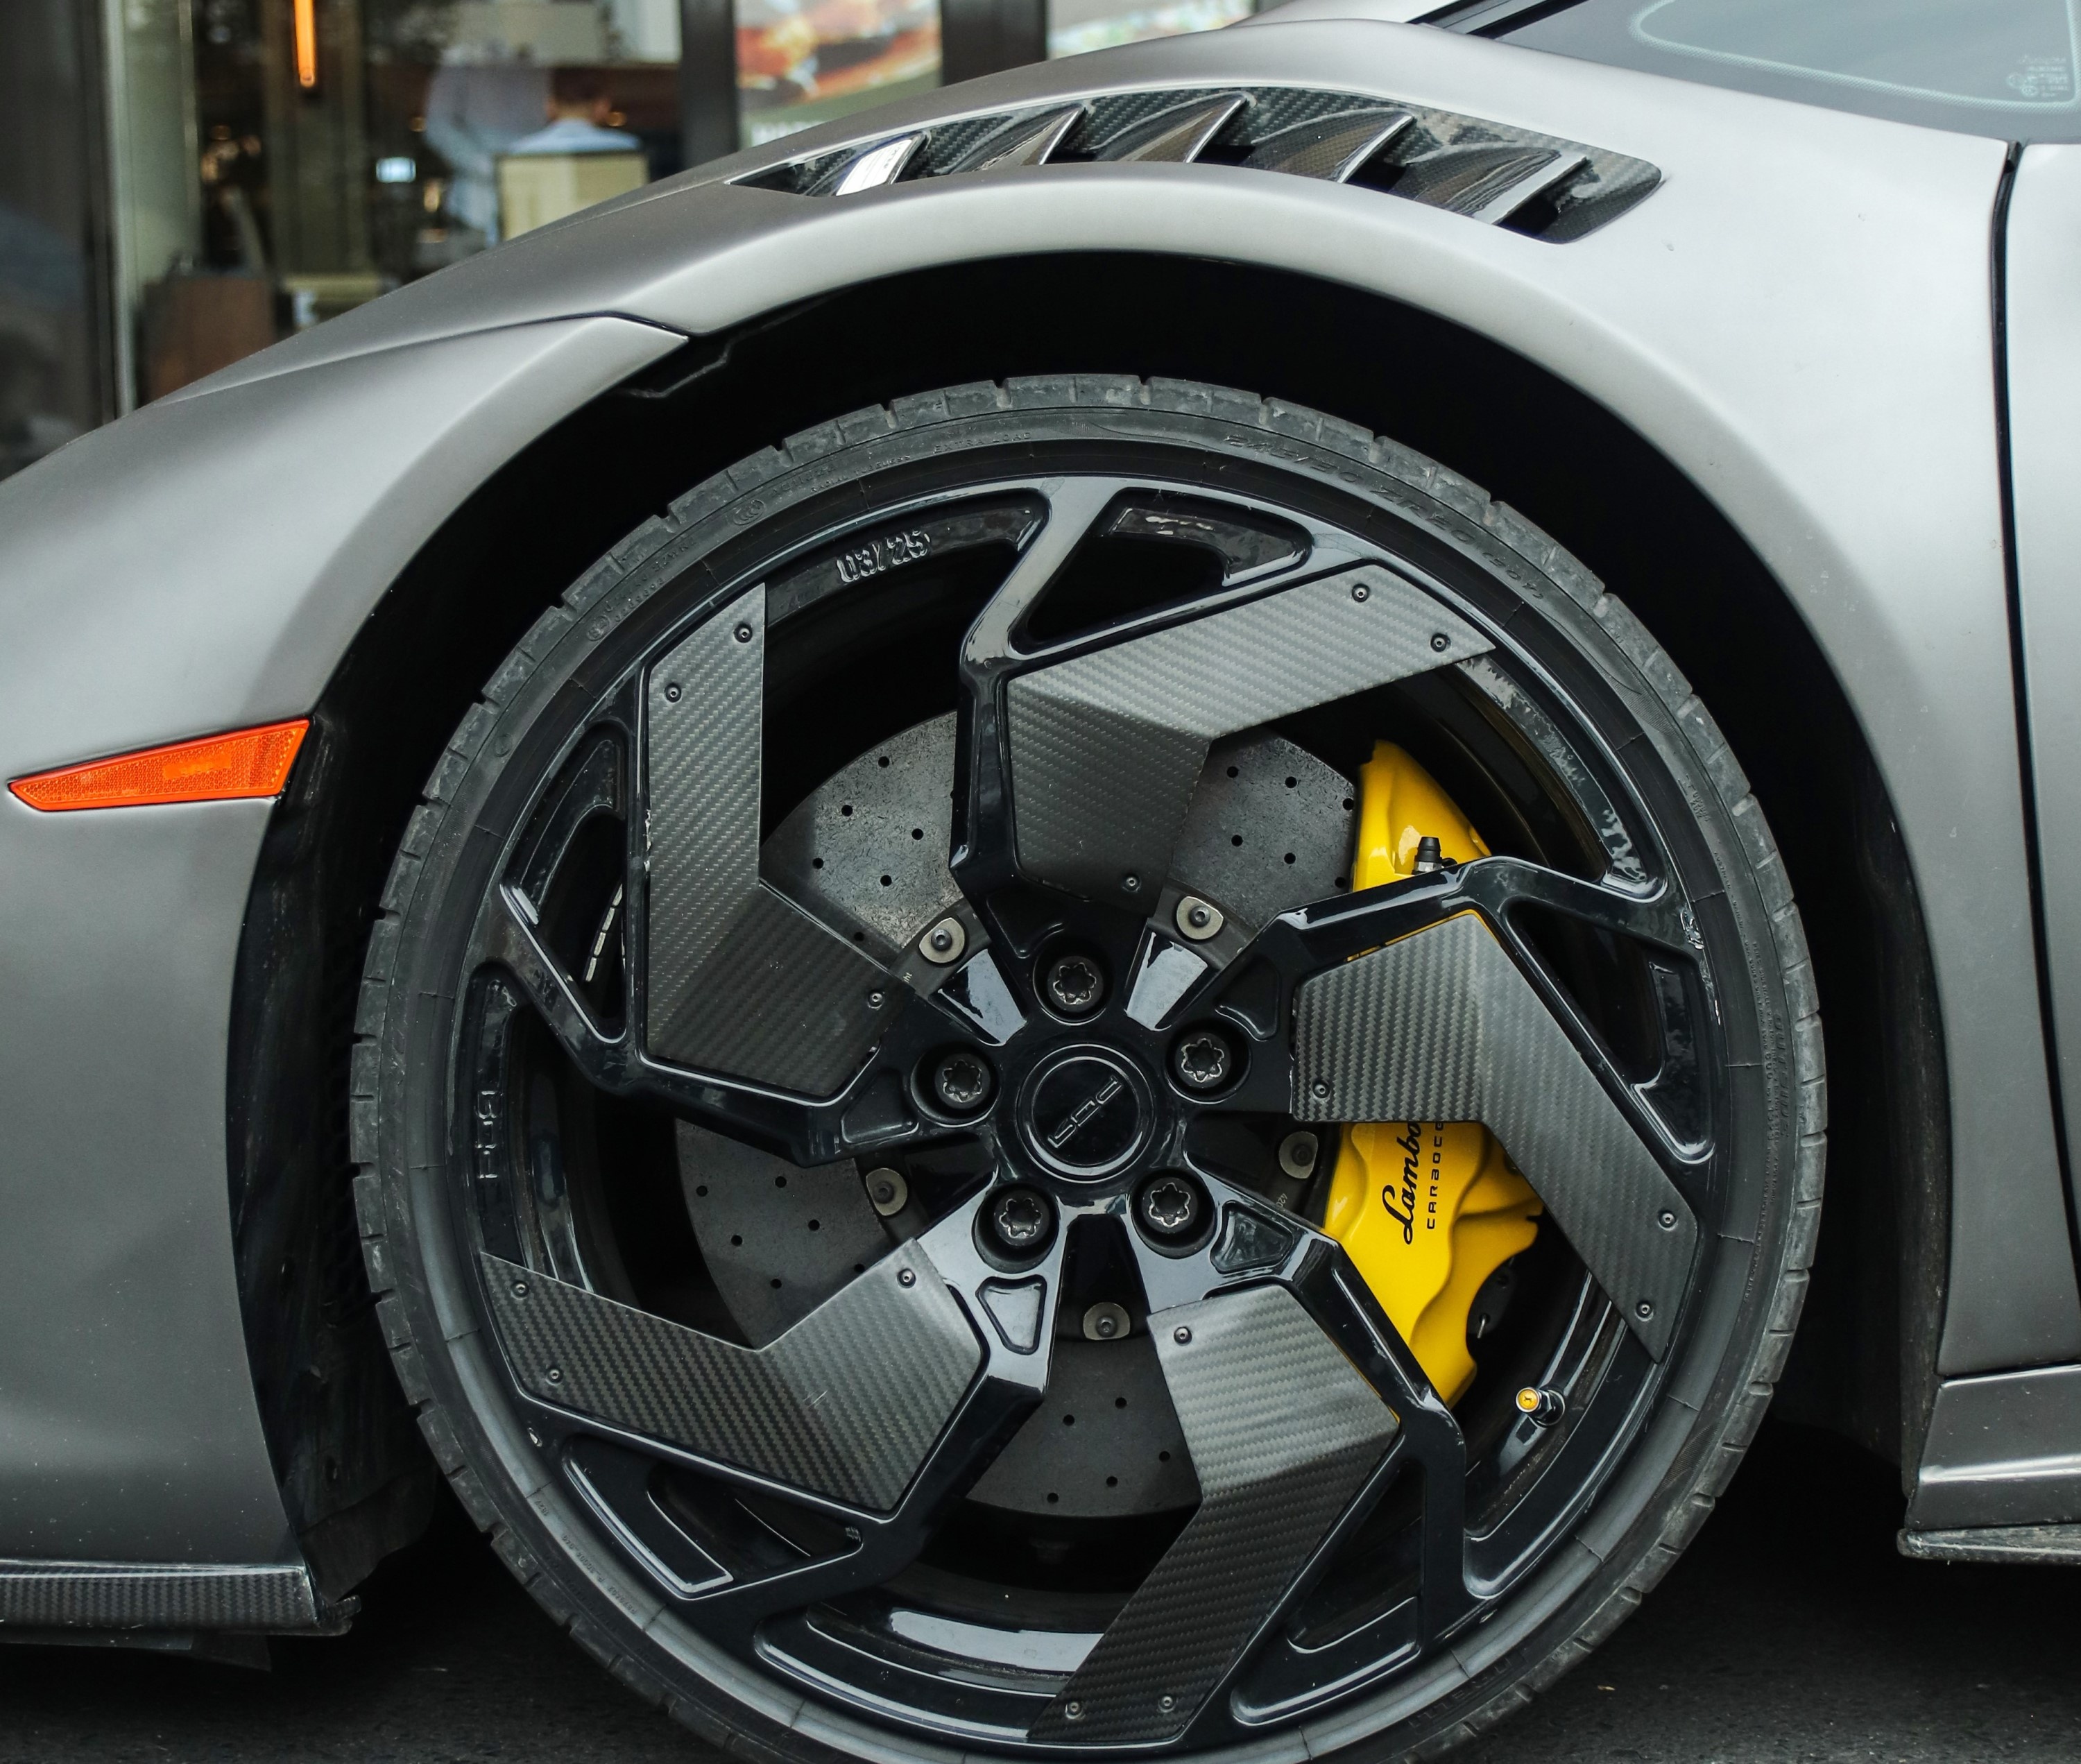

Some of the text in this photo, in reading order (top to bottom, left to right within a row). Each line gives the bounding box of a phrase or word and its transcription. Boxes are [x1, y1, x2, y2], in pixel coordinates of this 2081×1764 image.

[932, 431, 1031, 454] EXTRA LOAD
[1221, 433, 1364, 488] 245/30
[1382, 1121, 1421, 1244] Lambo
